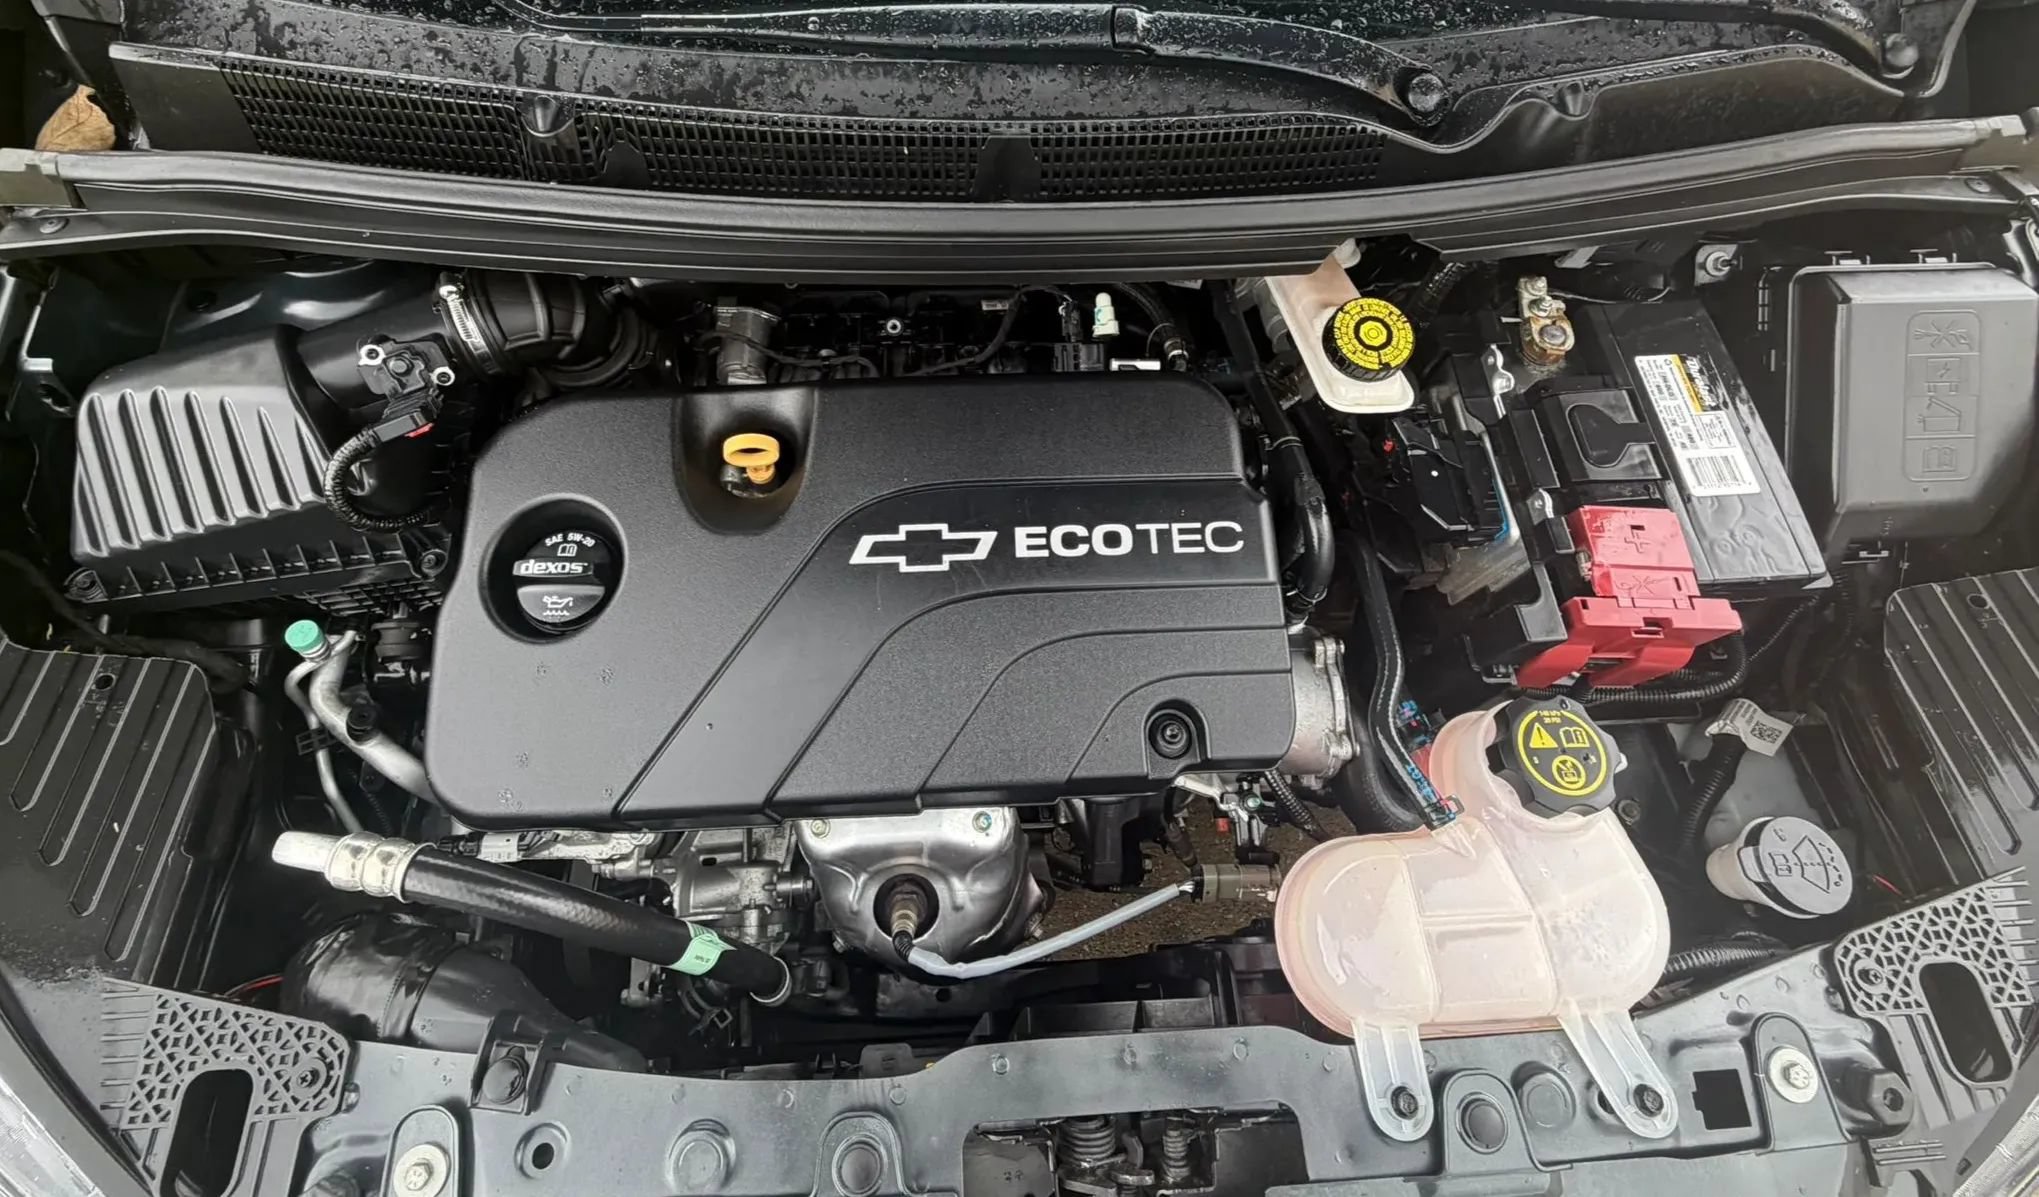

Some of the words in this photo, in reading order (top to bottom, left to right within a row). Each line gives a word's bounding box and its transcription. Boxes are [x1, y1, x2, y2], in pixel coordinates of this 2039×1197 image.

[545, 533, 564, 547] SAE
[567, 532, 595, 547] 5W-20
[1014, 521, 1244, 558] ECOTEC
[520, 559, 583, 574] dexos
